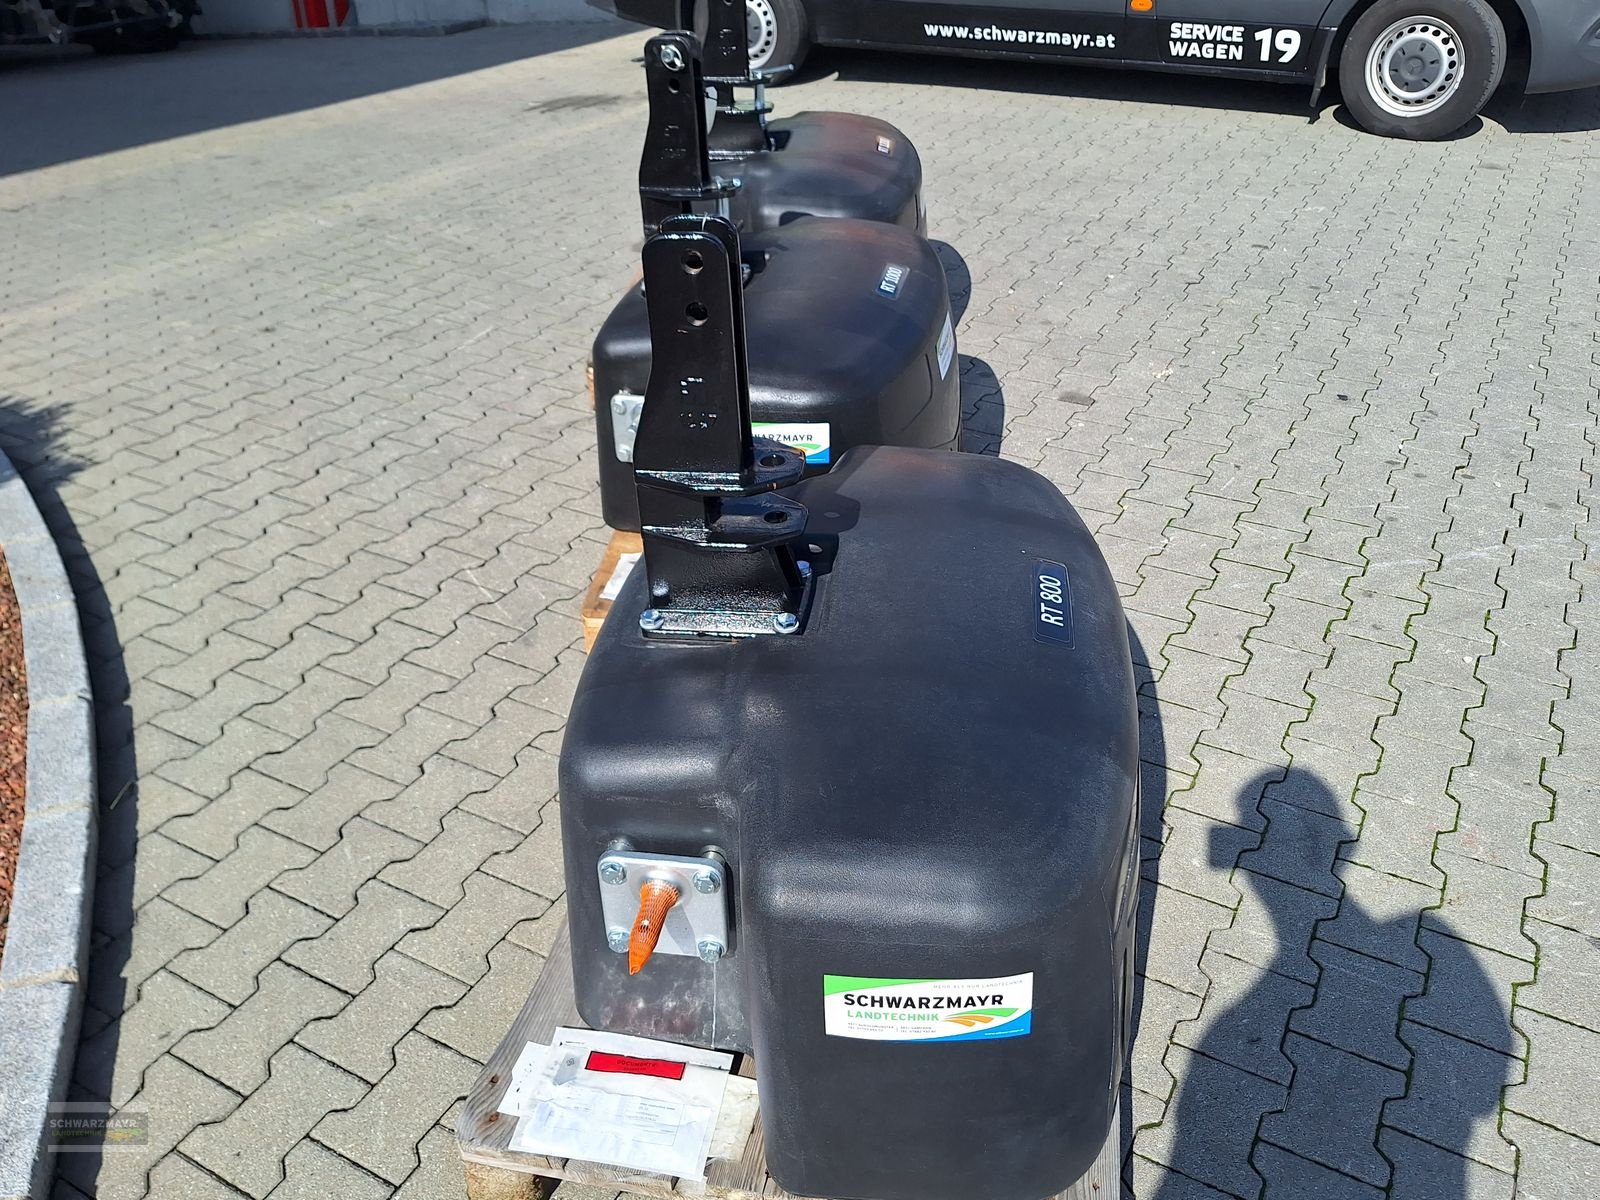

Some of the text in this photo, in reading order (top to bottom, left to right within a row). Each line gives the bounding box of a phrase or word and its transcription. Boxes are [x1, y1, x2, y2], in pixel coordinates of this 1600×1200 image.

[924, 21, 1116, 50] www.schwarzmayr.at
[1169, 22, 1245, 42] SERVICE
[1168, 40, 1244, 61] WAGEN
[1253, 27, 1302, 63] 19
[880, 280, 896, 293] RT
[1039, 575, 1064, 627] RT 800
[843, 993, 1004, 1009] SCHWARZMAYR
[847, 1009, 940, 1021] LANDTECHNIK
